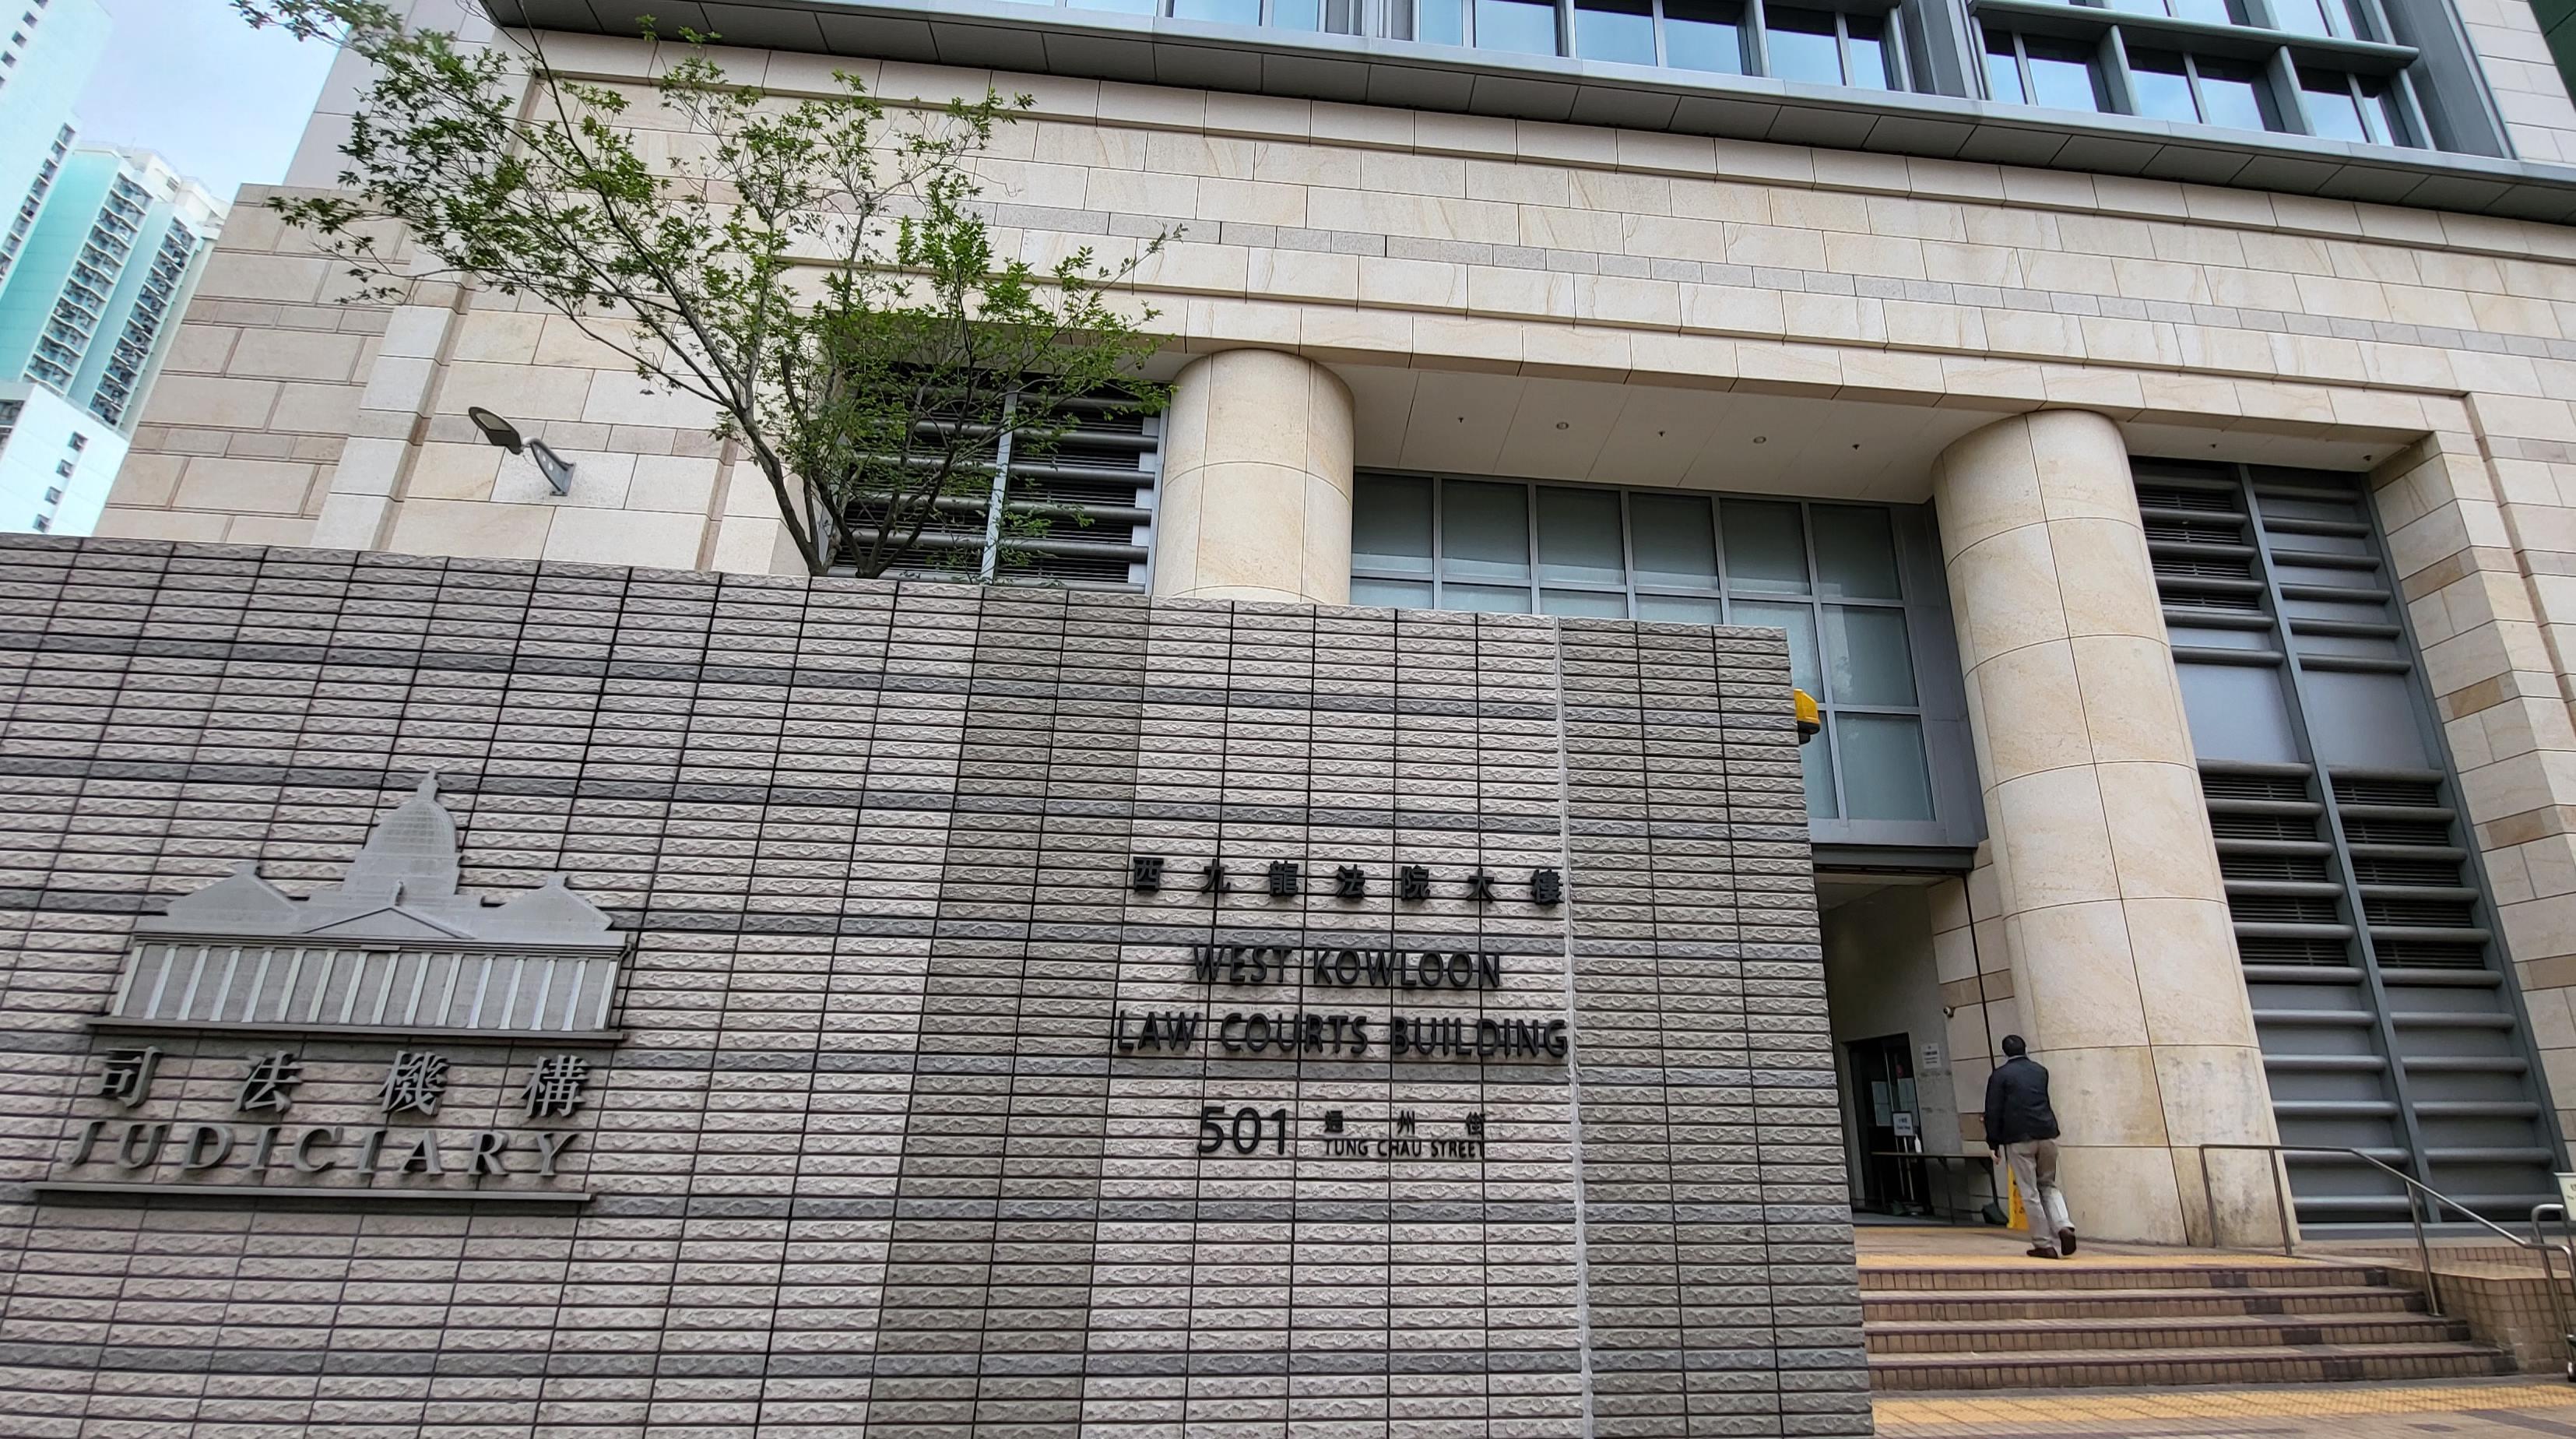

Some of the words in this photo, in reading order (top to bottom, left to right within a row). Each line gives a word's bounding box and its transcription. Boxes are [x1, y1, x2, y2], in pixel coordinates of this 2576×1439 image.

[1132, 857, 1562, 906] 西九龍法院大樓
[1193, 945, 1292, 983] WEST
[1313, 948, 1500, 987] KOWLOON
[1117, 1010, 1200, 1051] LAW
[1220, 1013, 1368, 1055] COURTS
[1390, 1016, 1569, 1059] BUILDING
[100, 1045, 589, 1118] 司法機構
[1197, 1105, 1287, 1156] 501
[1324, 1110, 1486, 1136] 通州街
[68, 1121, 578, 1177] JUDICIARY
[1325, 1139, 1369, 1156] TUNG
[1377, 1139, 1422, 1157] CHAU
[1431, 1140, 1485, 1159] STREET
